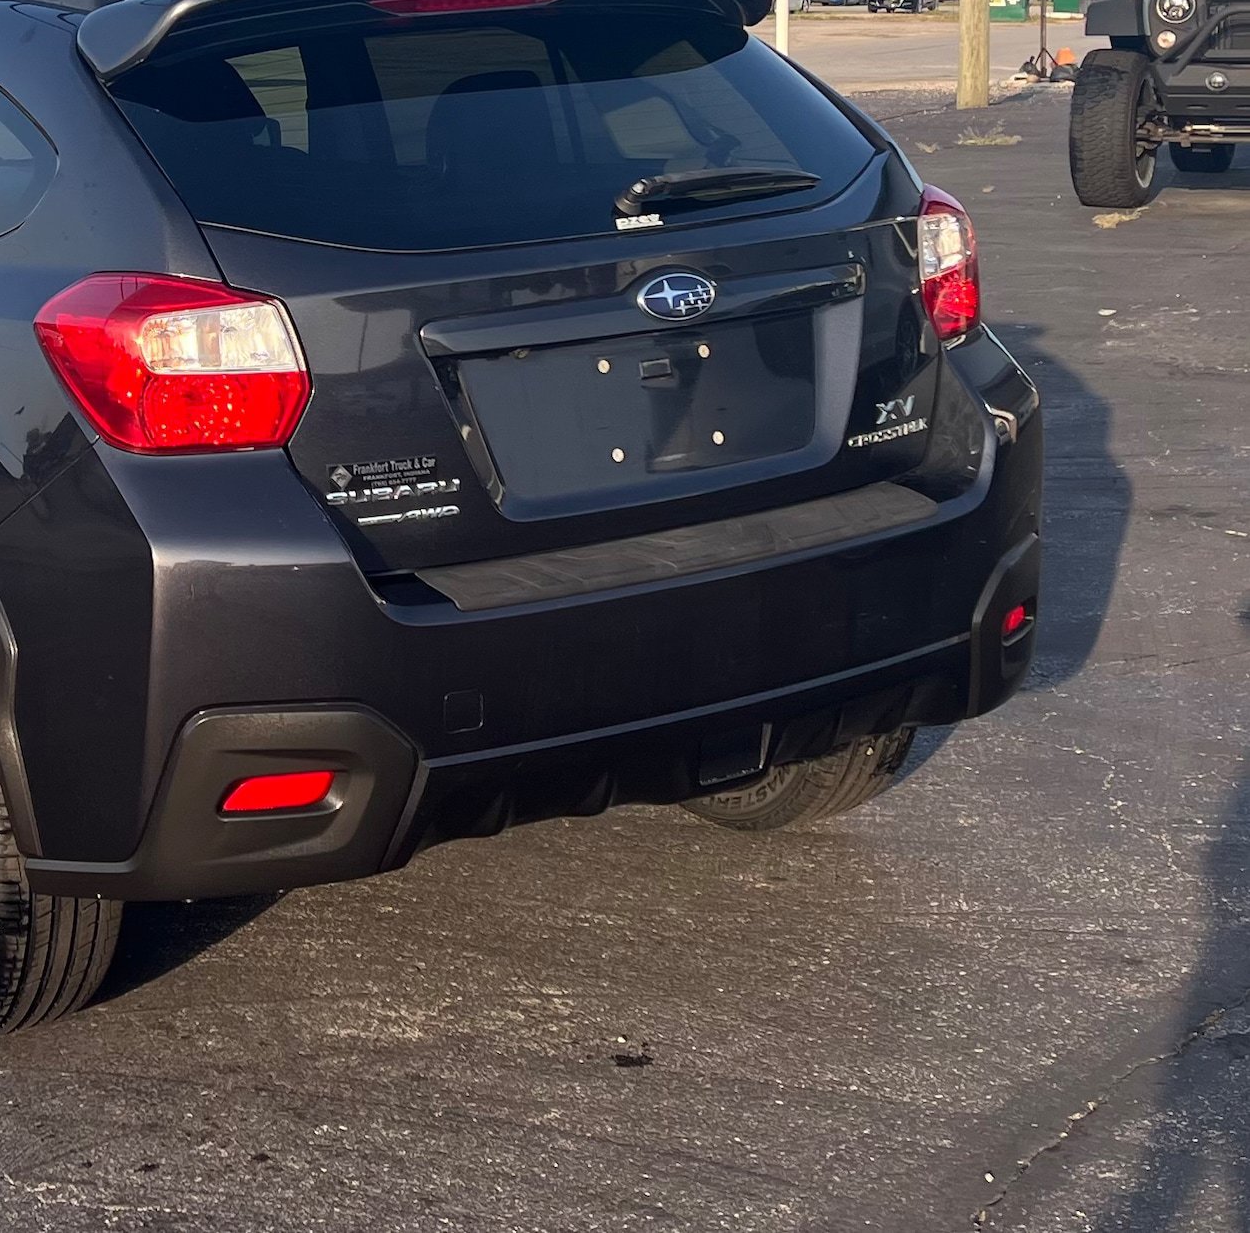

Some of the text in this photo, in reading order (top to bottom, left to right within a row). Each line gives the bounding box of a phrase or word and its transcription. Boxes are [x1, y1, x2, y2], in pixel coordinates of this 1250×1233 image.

[876, 395, 915, 424] XV
[353, 457, 436, 476] Frankfort Truck & Car
[326, 478, 460, 505] SUBARU
[403, 505, 460, 521] AWD
